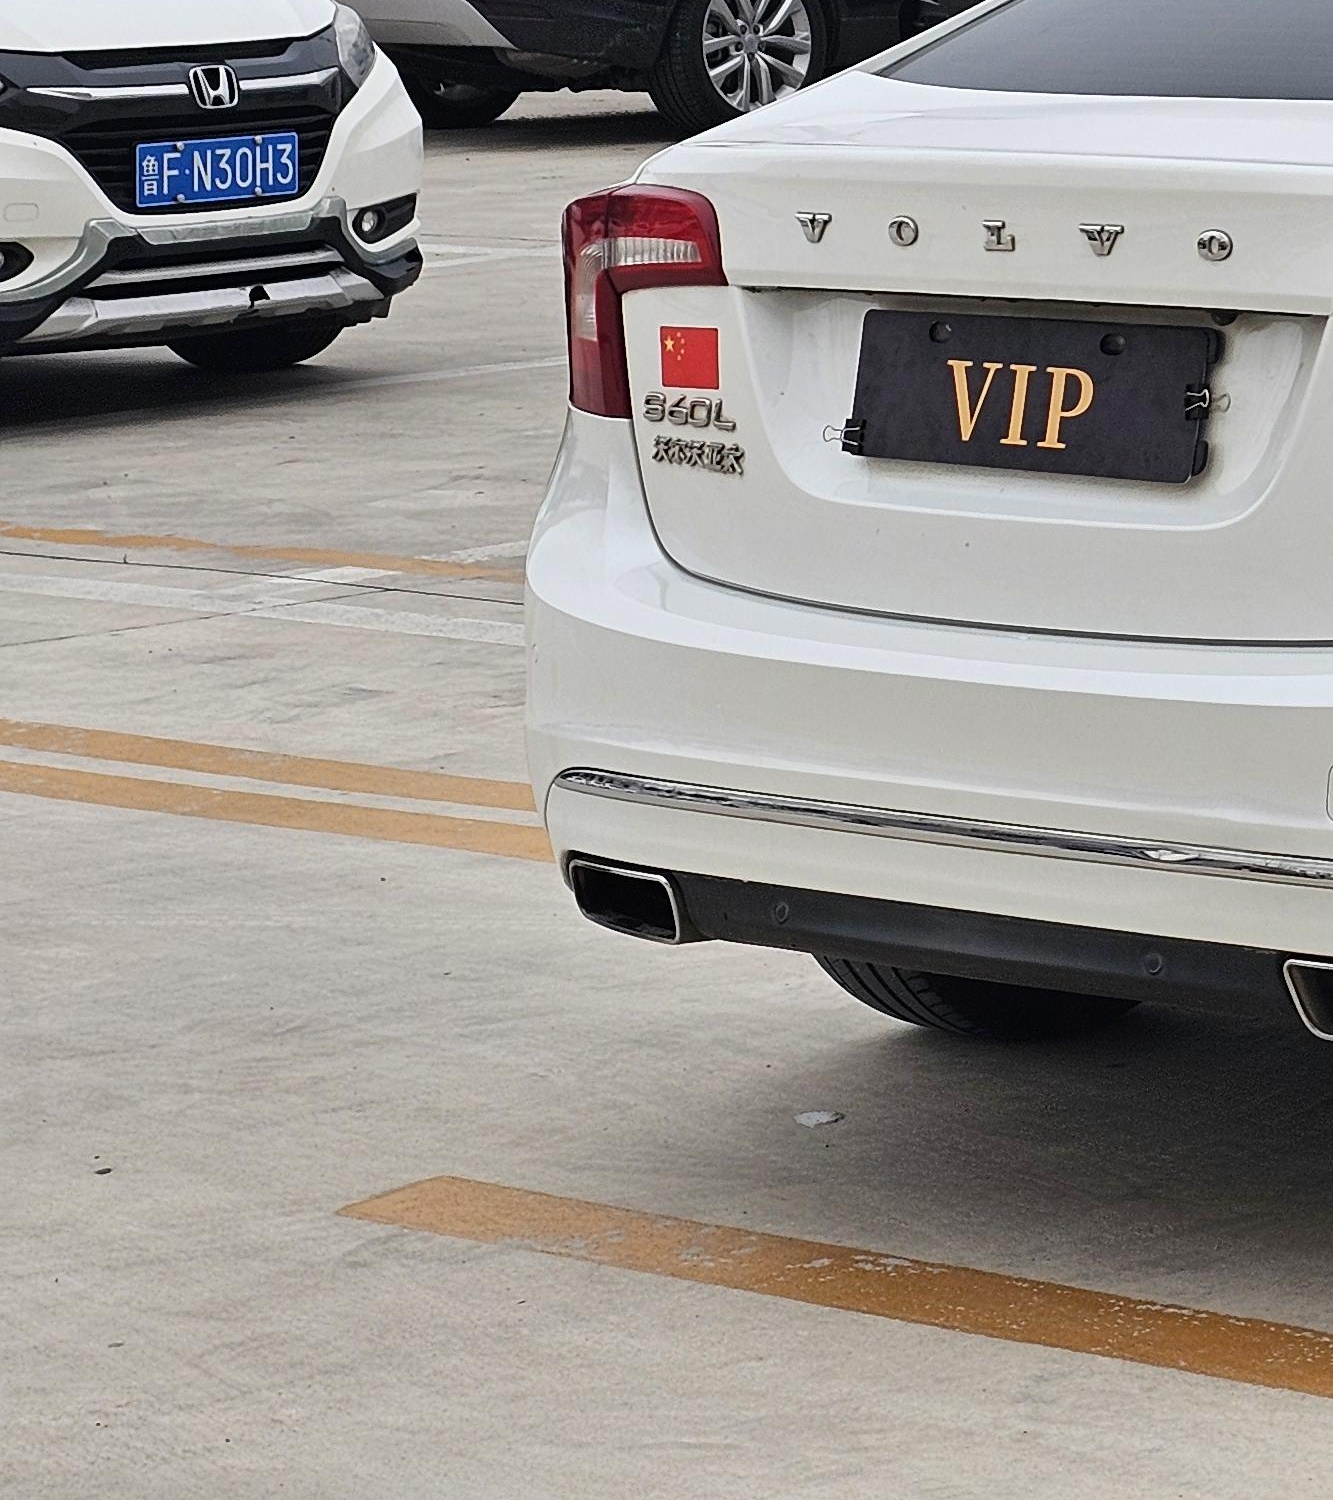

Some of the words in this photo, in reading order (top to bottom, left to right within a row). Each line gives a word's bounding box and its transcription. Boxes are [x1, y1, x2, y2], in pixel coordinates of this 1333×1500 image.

[141, 143, 294, 197] 鲁F·N30H3
[793, 211, 1234, 262] VOLVO
[643, 391, 737, 433] S60L
[946, 358, 1095, 449] VIP
[651, 434, 746, 476] 沃尔沃亚太
